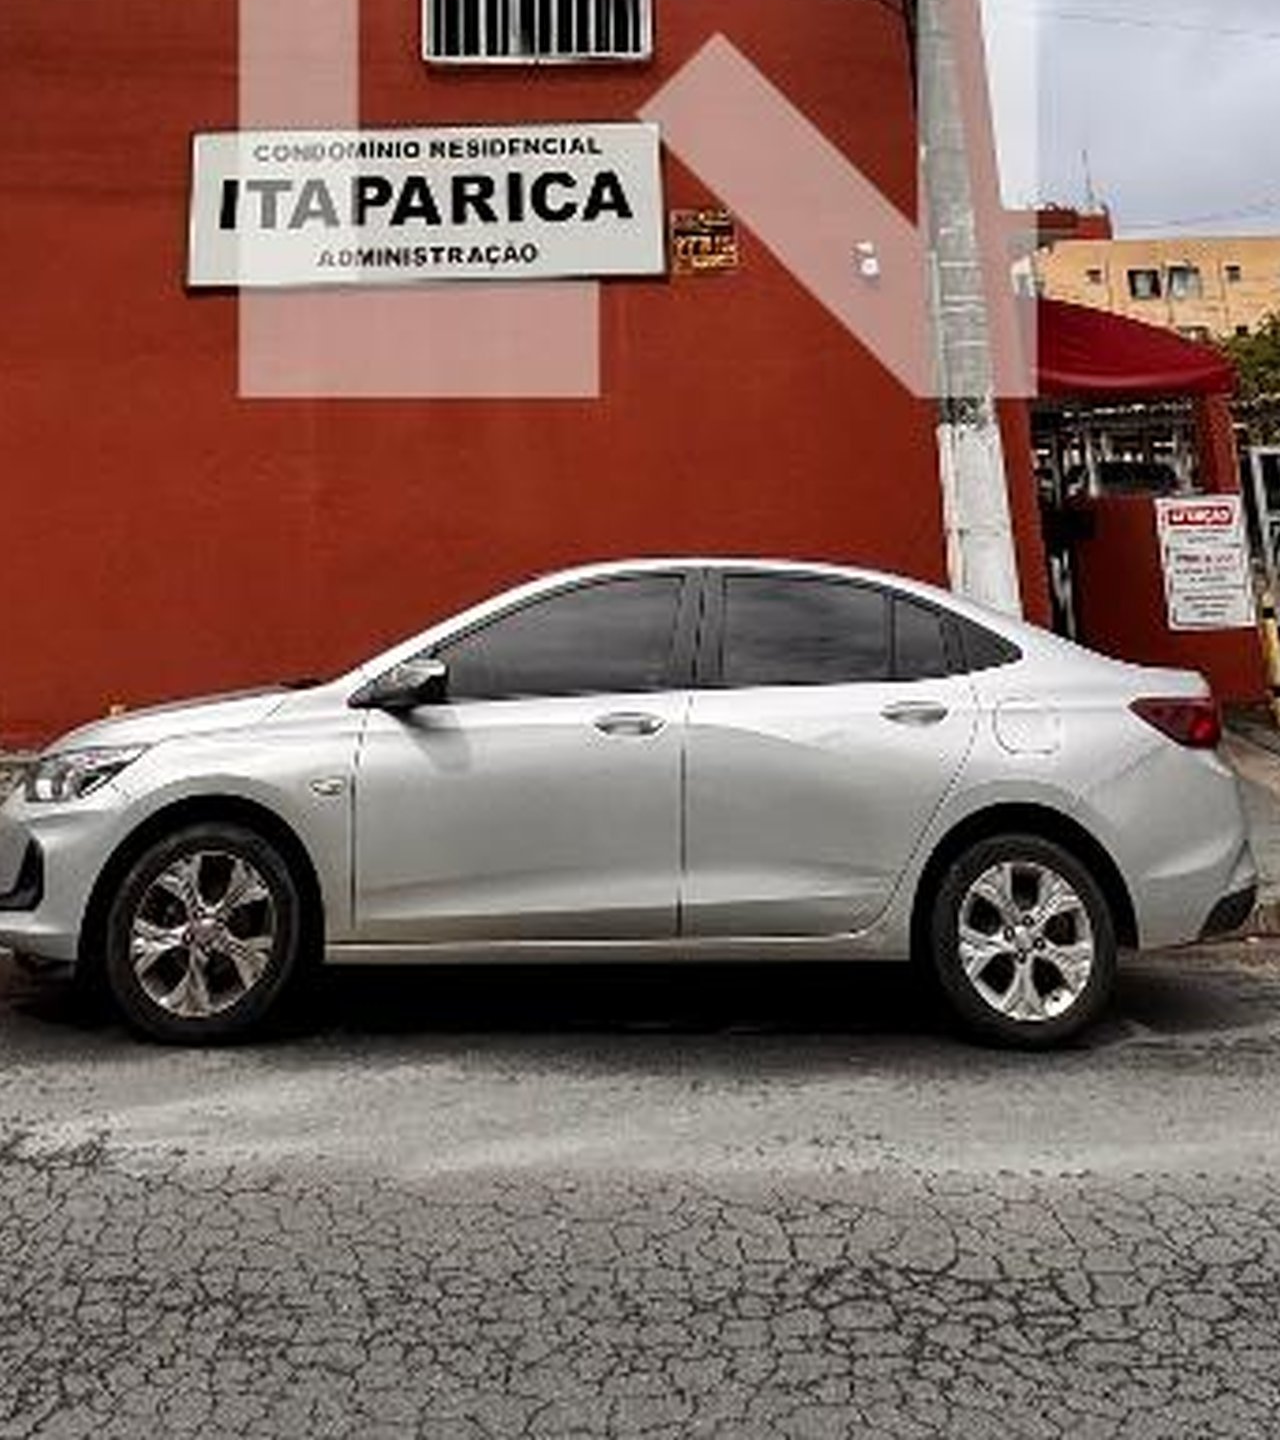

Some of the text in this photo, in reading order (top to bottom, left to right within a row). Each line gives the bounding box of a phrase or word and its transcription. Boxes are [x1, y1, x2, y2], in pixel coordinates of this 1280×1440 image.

[429, 137, 602, 159] RESIDENCIAL
[219, 170, 634, 230] ITAPARICA
[317, 240, 538, 270] ADMINISTRAÇÃO
